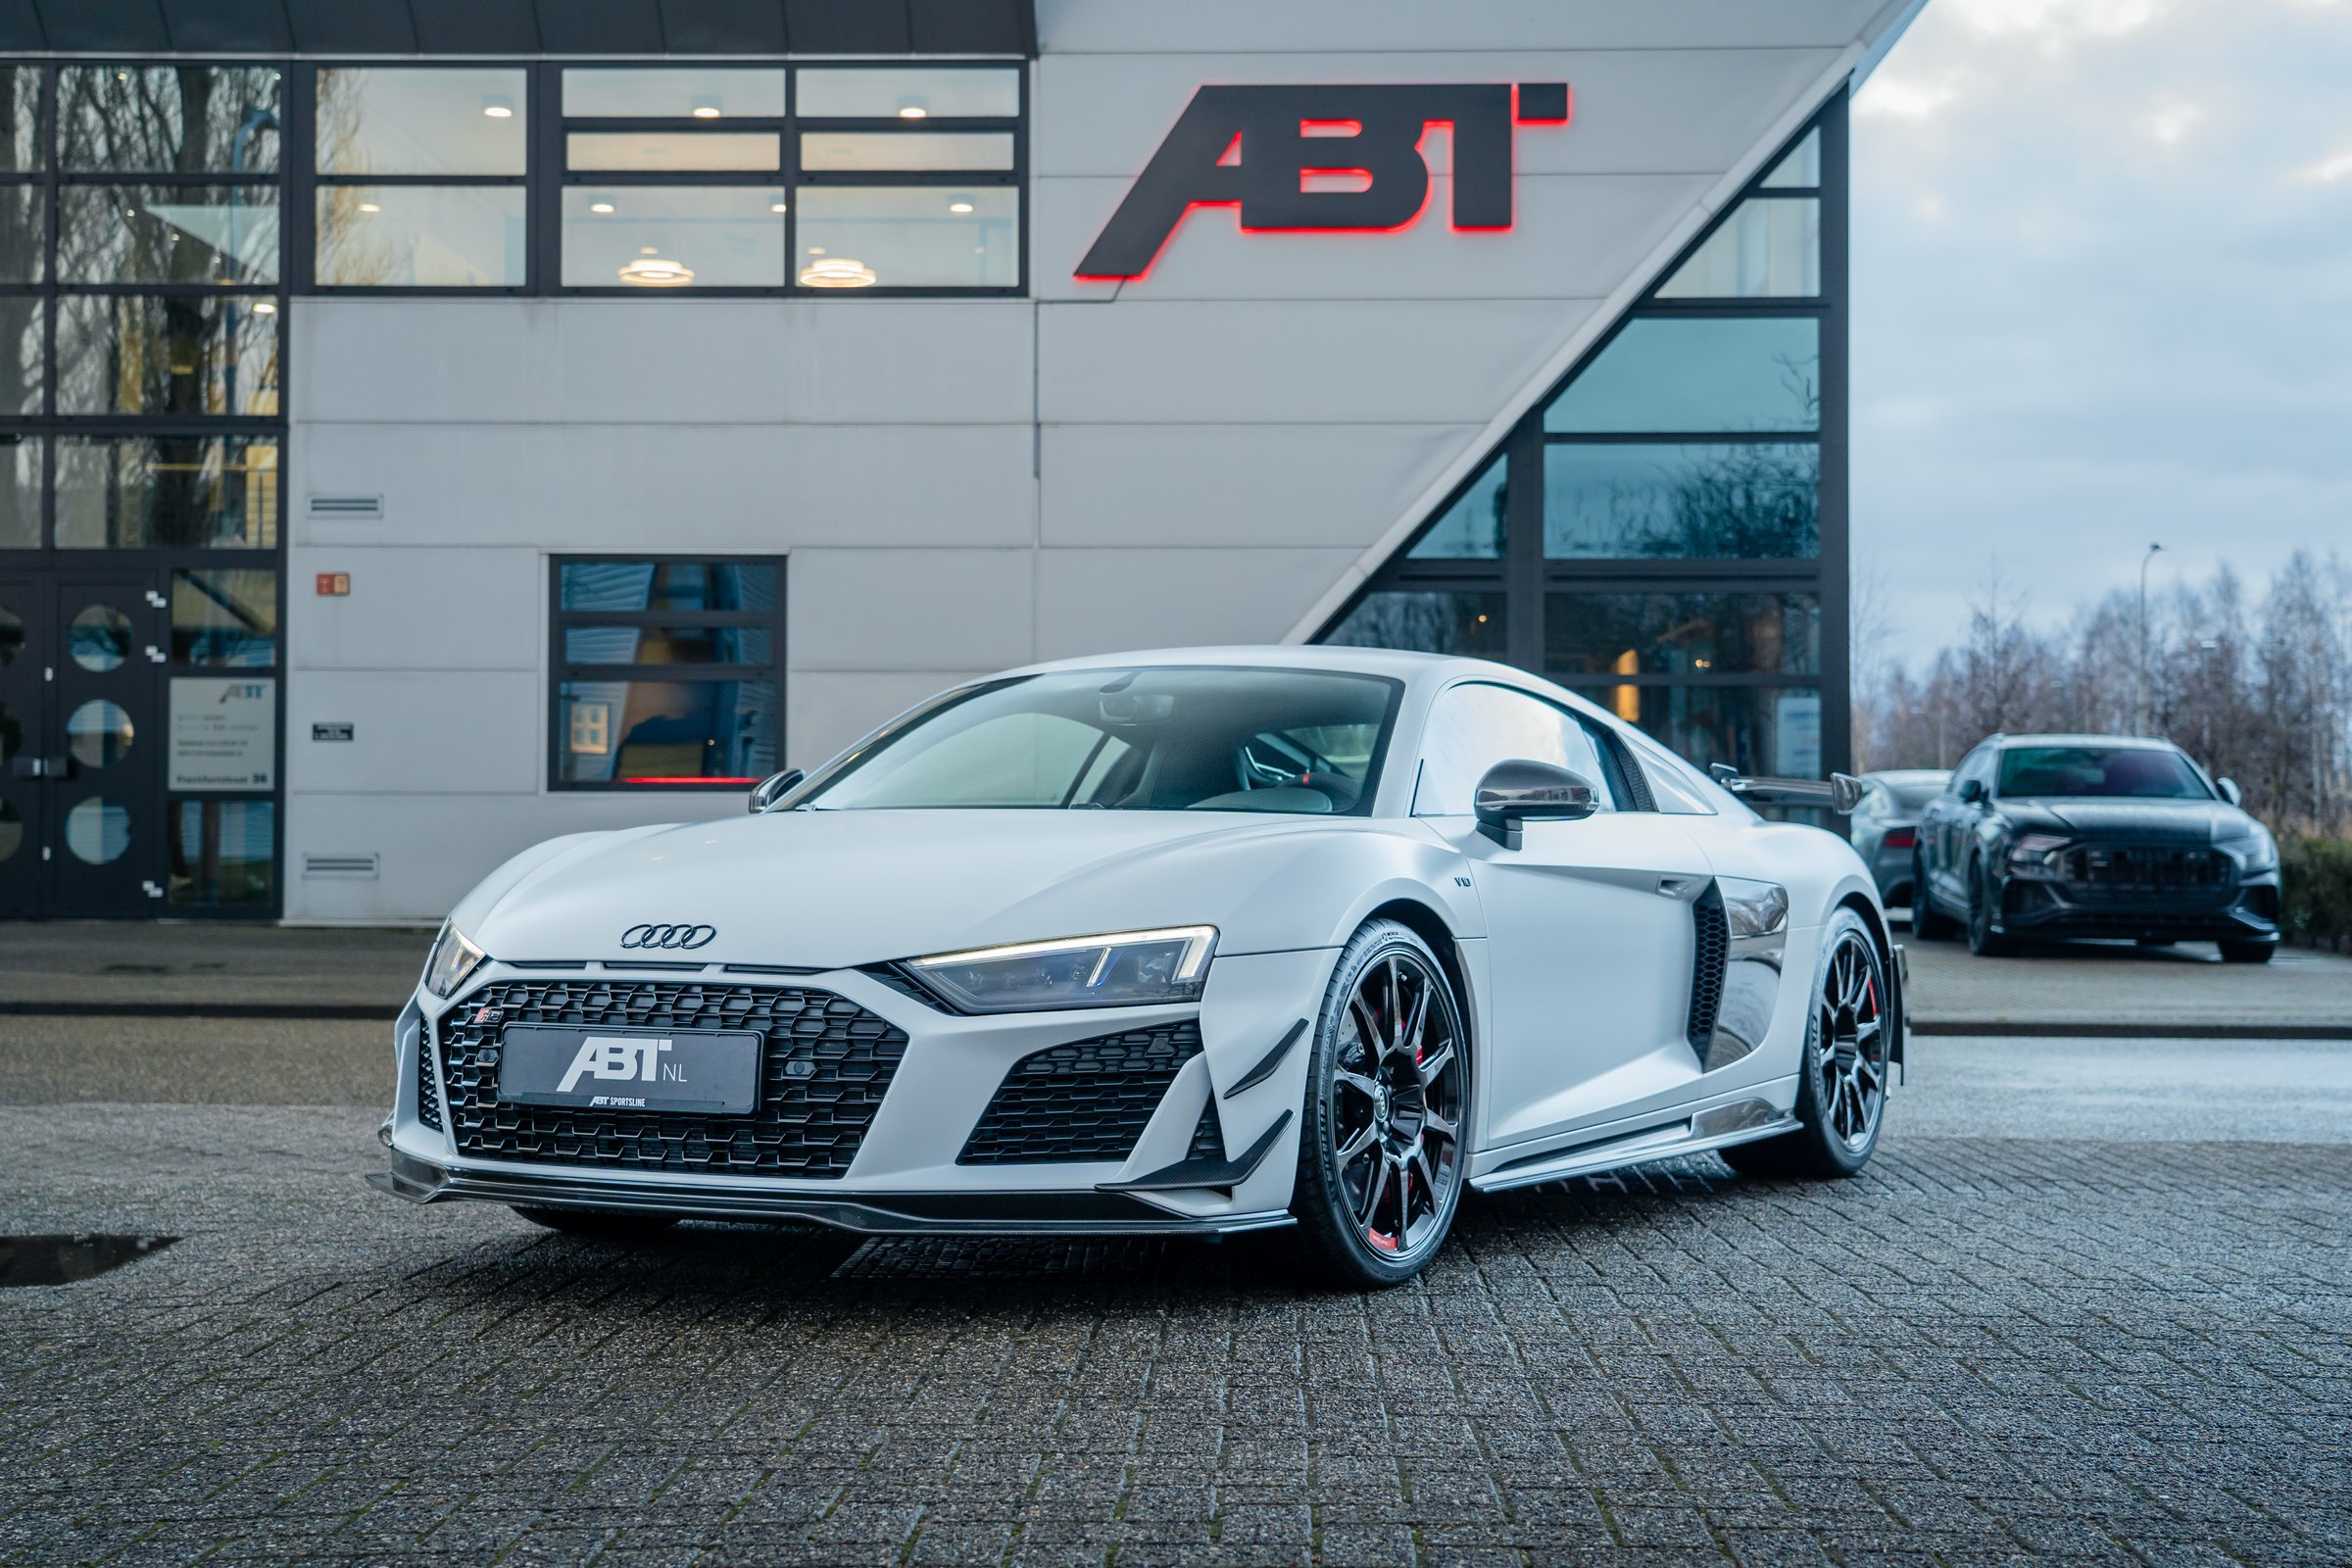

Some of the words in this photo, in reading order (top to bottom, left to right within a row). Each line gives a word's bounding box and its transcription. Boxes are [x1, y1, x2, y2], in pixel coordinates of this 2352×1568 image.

[1073, 83, 1568, 279] ABT
[556, 1036, 672, 1093] ABT
[662, 1062, 688, 1082] NL
[589, 1096, 610, 1107] ABT
[610, 1097, 646, 1107] SPORTSLINE
